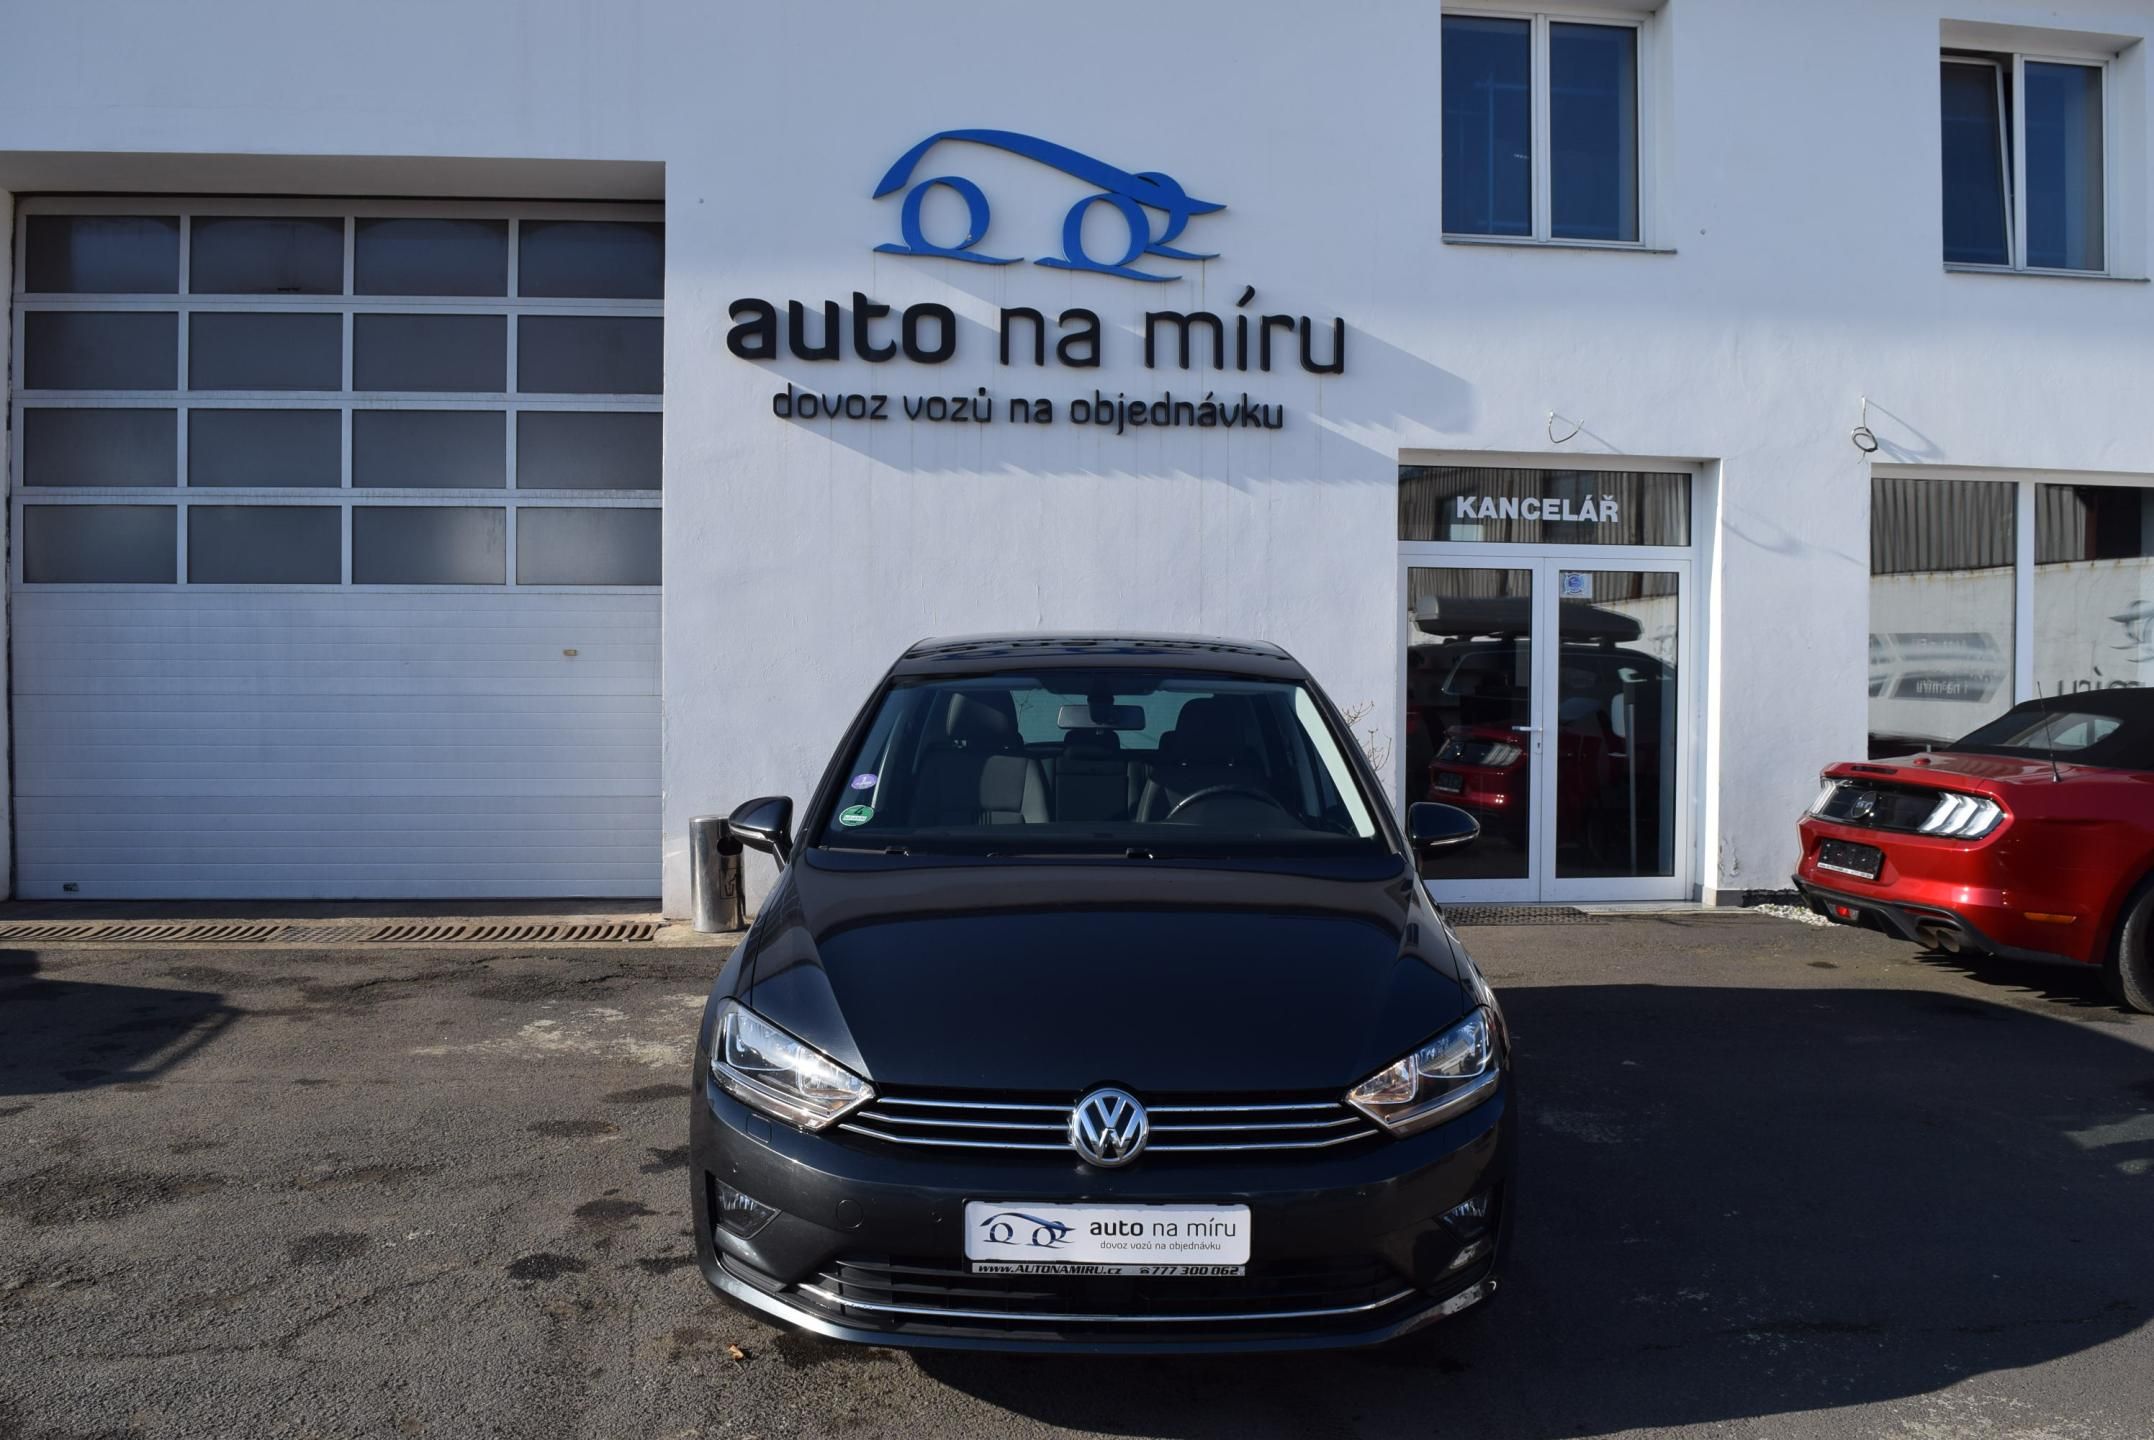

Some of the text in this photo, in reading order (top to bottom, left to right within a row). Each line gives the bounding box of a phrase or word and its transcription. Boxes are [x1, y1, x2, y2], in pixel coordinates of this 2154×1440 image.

[726, 284, 1345, 375] auto na míru
[772, 383, 1284, 437] dovoz vozů na objednávku
[1456, 495, 1619, 523] KANCELÁŘ
[1090, 1217, 1236, 1237] auto na míru
[1100, 1240, 1221, 1253] dovoz vozů na objednávku
[978, 1264, 1123, 1276] www.AUTONAMIRU.cz
[1180, 1266, 1209, 1276] 300
[1211, 1267, 1239, 1276] 062
